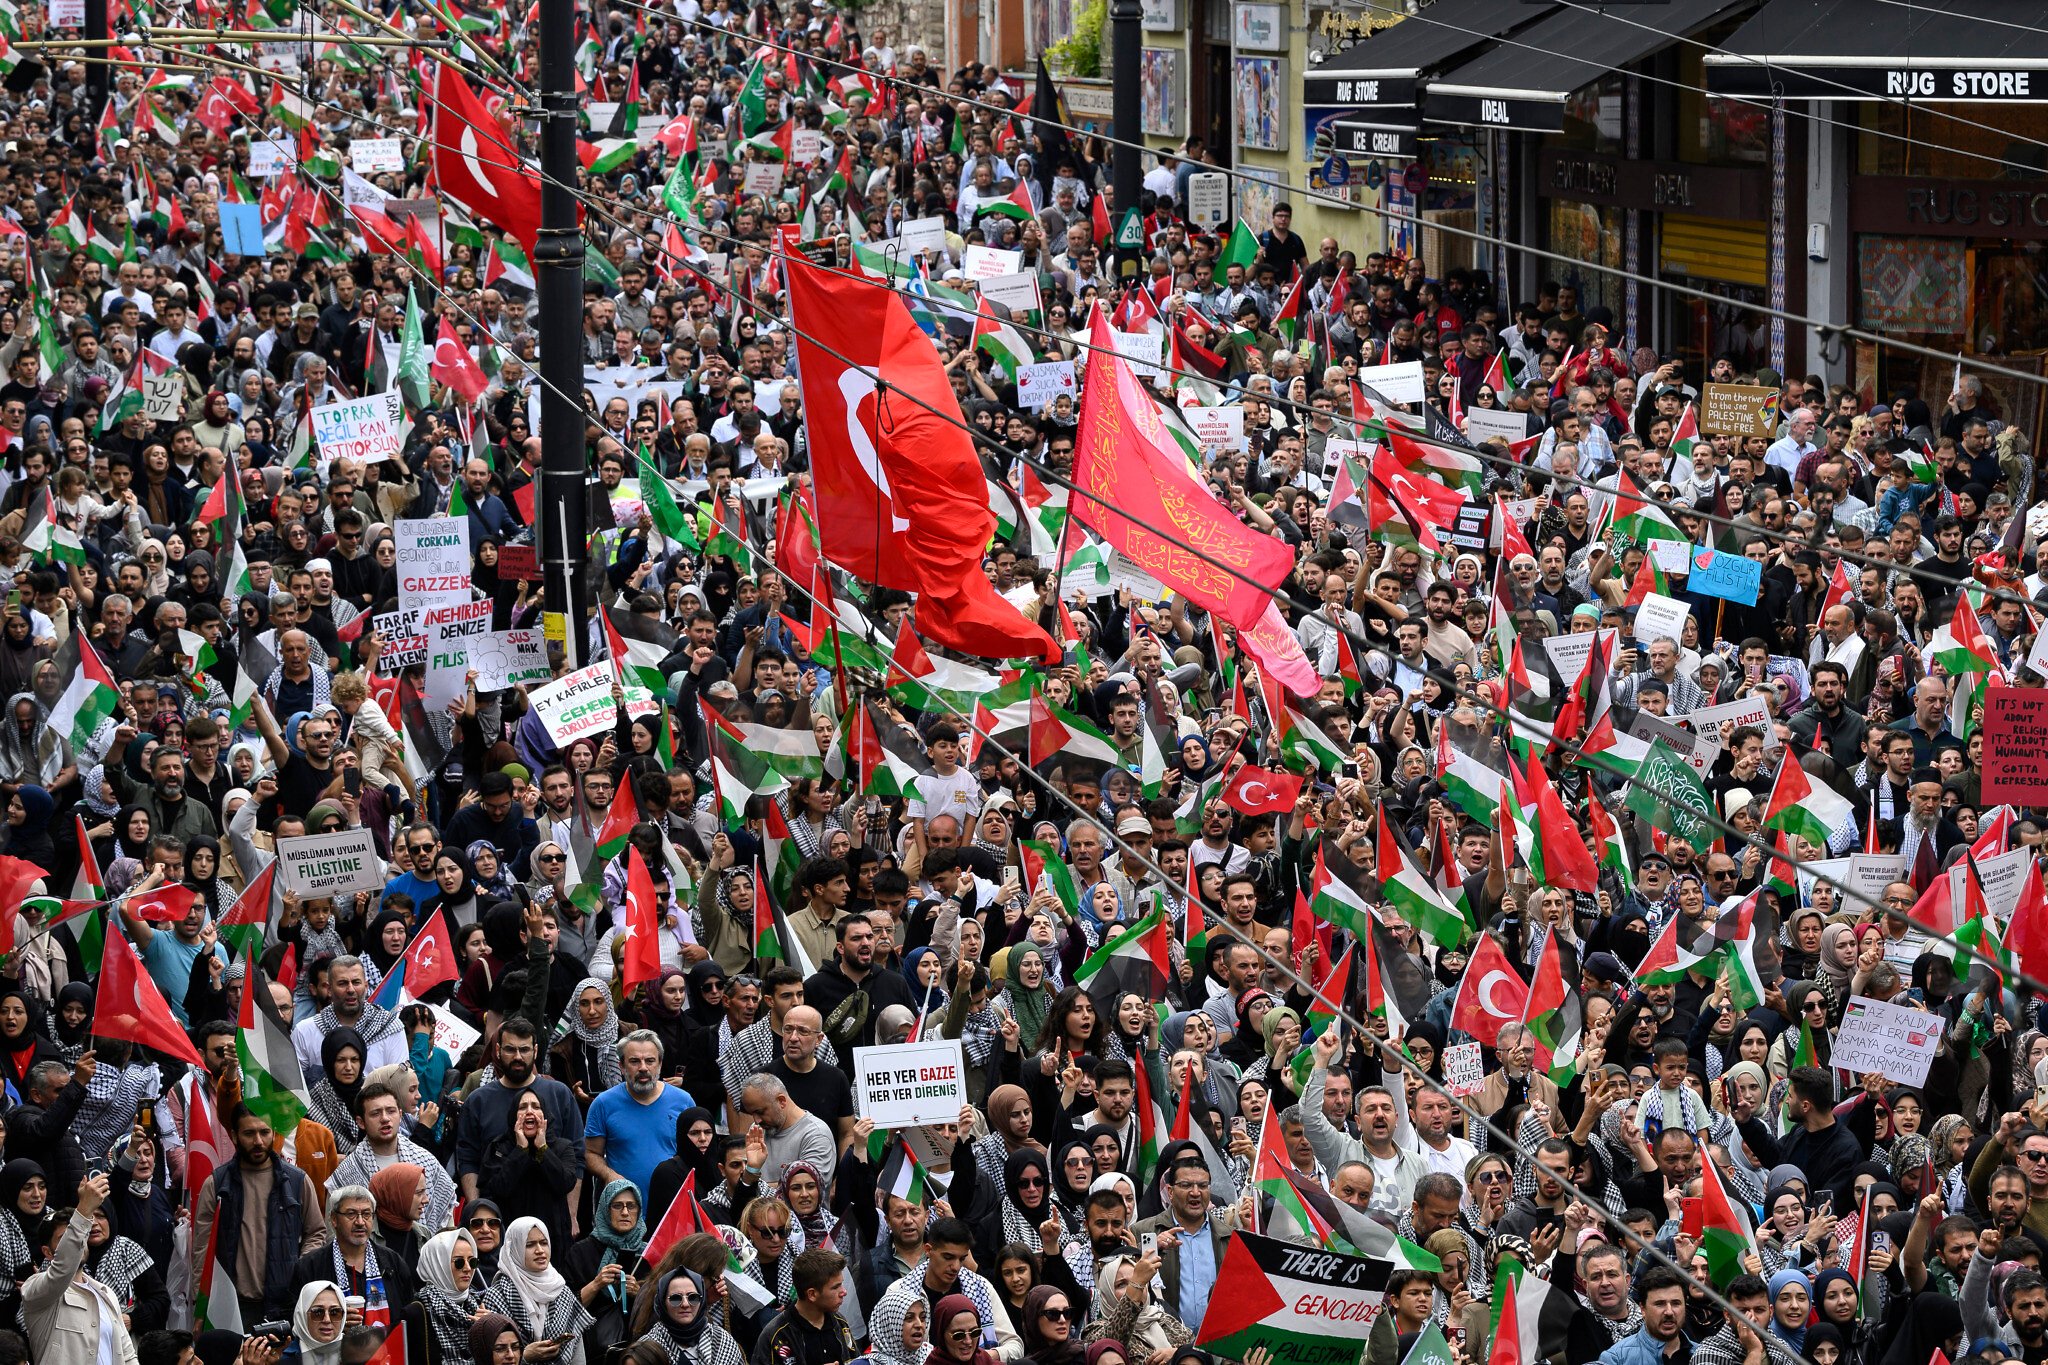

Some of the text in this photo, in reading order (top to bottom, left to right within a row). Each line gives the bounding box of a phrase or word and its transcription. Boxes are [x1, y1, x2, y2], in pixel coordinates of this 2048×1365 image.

[1337, 81, 1378, 101] RUG STORE
[1887, 71, 2030, 95] RUG STORE
[1481, 99, 1510, 123] IDEAL
[1354, 132, 1400, 153] ICE CREAM
[1906, 189, 1979, 225] RUG
[1126, 226, 1140, 239] 30
[1709, 386, 1763, 404] from the river
[317, 403, 376, 424] TOPRAK
[1709, 401, 1748, 411] to the sea
[1708, 410, 1754, 423] PALESTINE
[359, 420, 387, 437] KAN
[1707, 422, 1755, 434] will be FREE
[401, 520, 459, 537] ÖLÜMDEN
[417, 534, 461, 549] KORKMA
[397, 548, 442, 564] ÇÜNKÜ
[1714, 553, 1755, 577] ÖZGÜR
[428, 561, 460, 575] ÖLÜM
[374, 609, 419, 630] TARAF
[516, 643, 539, 654] MAK
[535, 697, 551, 713] EY
[560, 688, 643, 723] CEHENNME
[2023, 700, 2044, 712] NOT
[1699, 722, 1718, 734] HER
[1736, 710, 1765, 727] GAZZE
[2003, 713, 2035, 724] ABOUT
[2014, 735, 2048, 747] ABOUT
[286, 843, 368, 863] MÜSLÜMAN UYUMA
[298, 857, 363, 879] FİLİSTİNE
[310, 874, 355, 889] SAHİP ÇIK!
[1866, 1006, 1928, 1029] AZ KALDI
[1842, 1017, 1906, 1041] DENİZLERİ
[1836, 1033, 1879, 1050] ASMAYA
[1450, 1048, 1474, 1064] BABY
[867, 1065, 956, 1087] HER YER GAZZE
[1450, 1058, 1482, 1076] KILLER
[869, 1081, 957, 1103] HER YER DİRENİŞ
[1279, 1248, 1366, 1285] THERE IS
[1293, 1293, 1380, 1323] GENOCIDE
